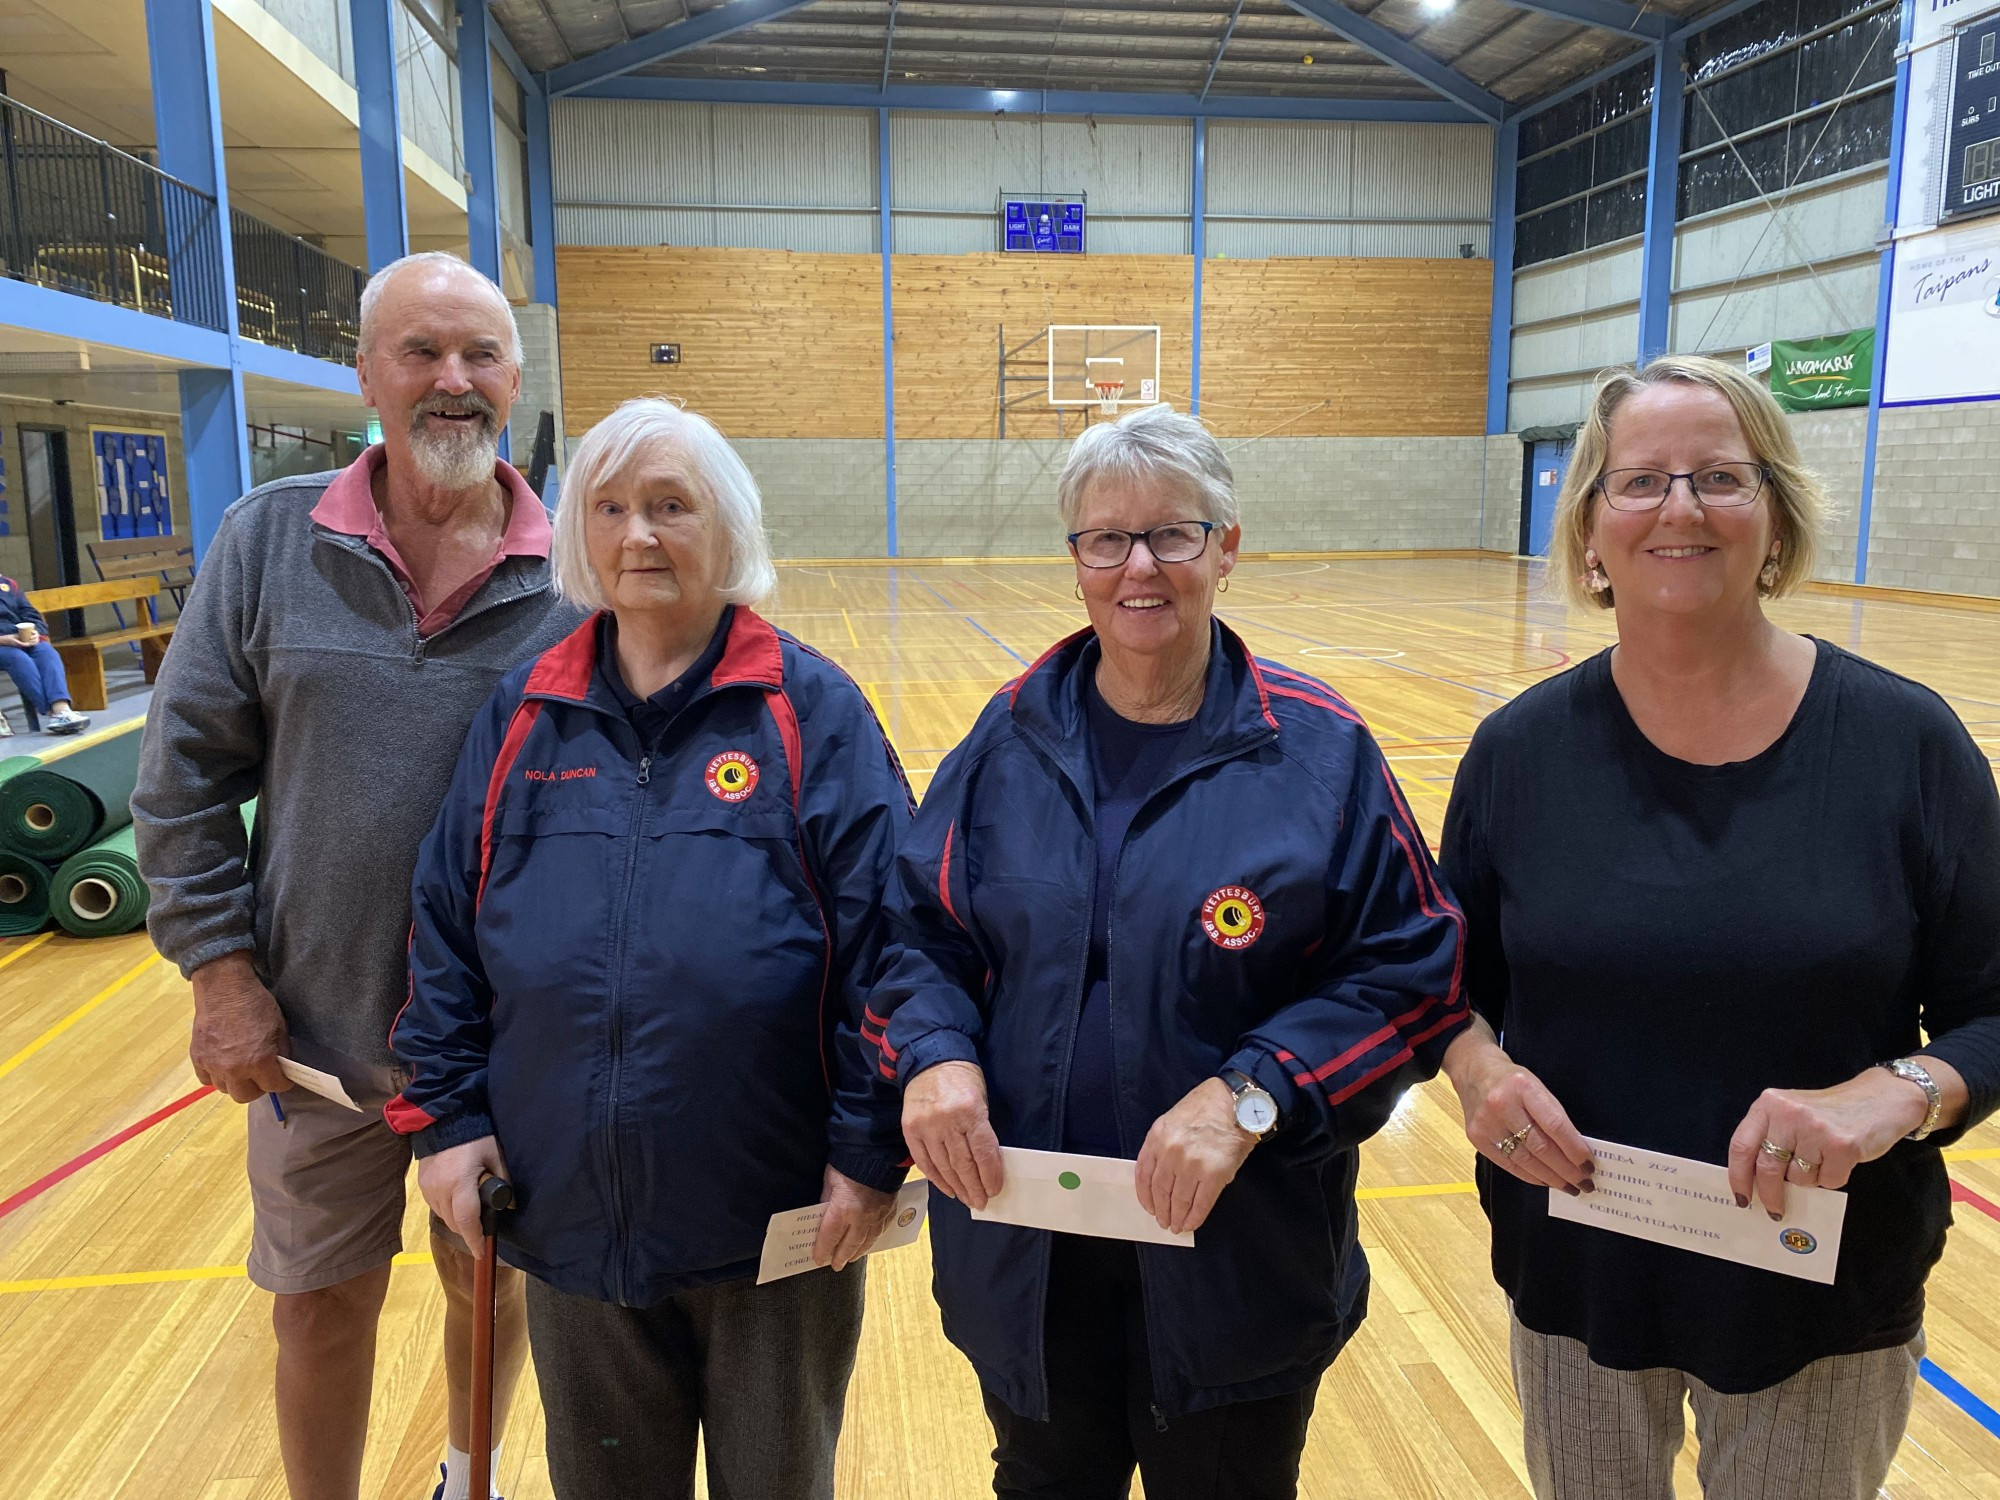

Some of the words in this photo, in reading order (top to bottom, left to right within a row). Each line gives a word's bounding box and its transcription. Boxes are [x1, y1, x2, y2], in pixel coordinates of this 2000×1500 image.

[1968, 67, 1984, 80] TIME
[1961, 114, 1980, 127] SUBS
[1963, 181, 2000, 204] LIGHT
[1064, 224, 1080, 232] DARK
[1910, 261, 1933, 271] HOME
[1936, 259, 1946, 267] OF
[1949, 255, 1966, 264] THE
[1913, 258, 1992, 304] Taipans
[1785, 354, 1855, 375] LANDMARK
[708, 753, 757, 776] HEYTESBURY
[525, 769, 556, 781] NOLA
[560, 767, 596, 781] DUNCAN
[1204, 888, 1262, 919] HEYTESBURY
[1648, 1161, 1678, 1175] 2022
[1655, 1182, 1753, 1210] TOURNAMET
[1590, 1203, 1721, 1240] CONGRATULATIONS
[1785, 1233, 1811, 1248] SUPER
